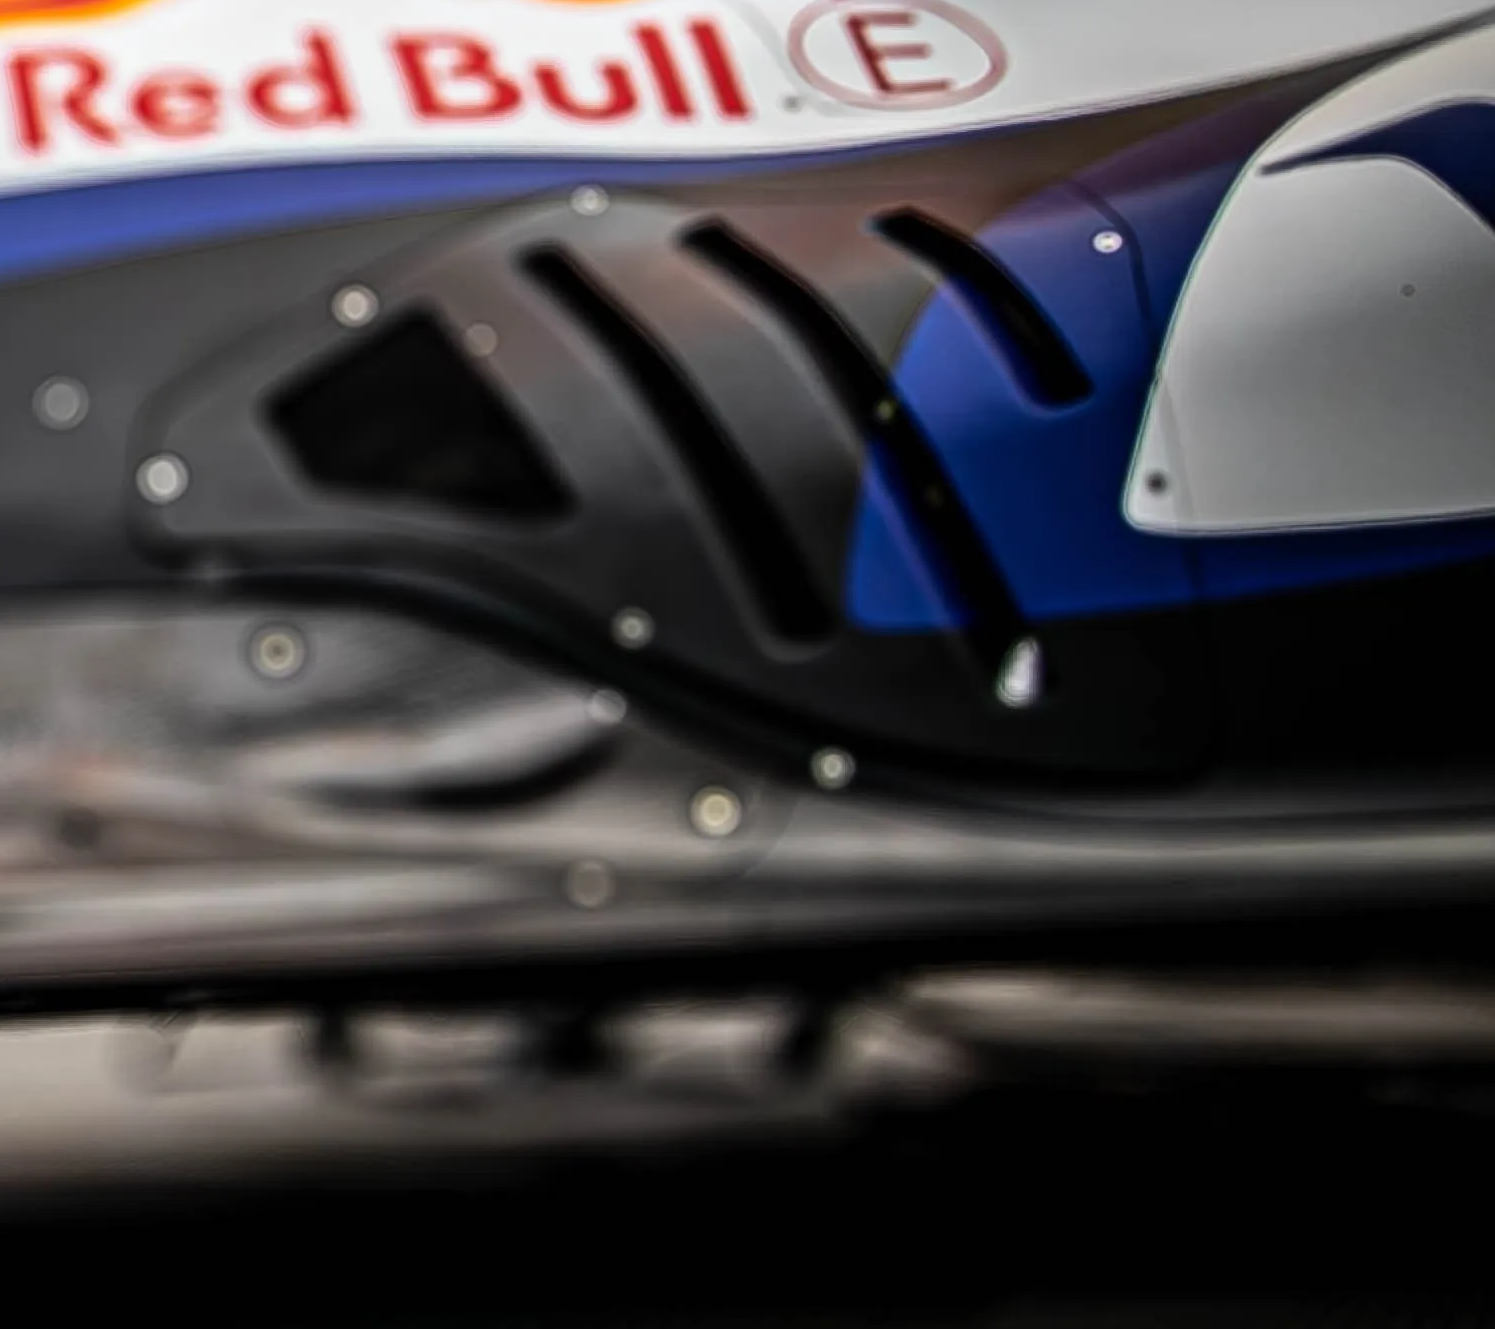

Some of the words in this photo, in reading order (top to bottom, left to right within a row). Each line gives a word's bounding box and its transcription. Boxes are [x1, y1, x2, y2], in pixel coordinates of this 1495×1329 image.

[4, 24, 355, 159] Red
[390, 17, 755, 125] Bull
[846, 11, 953, 97] E
